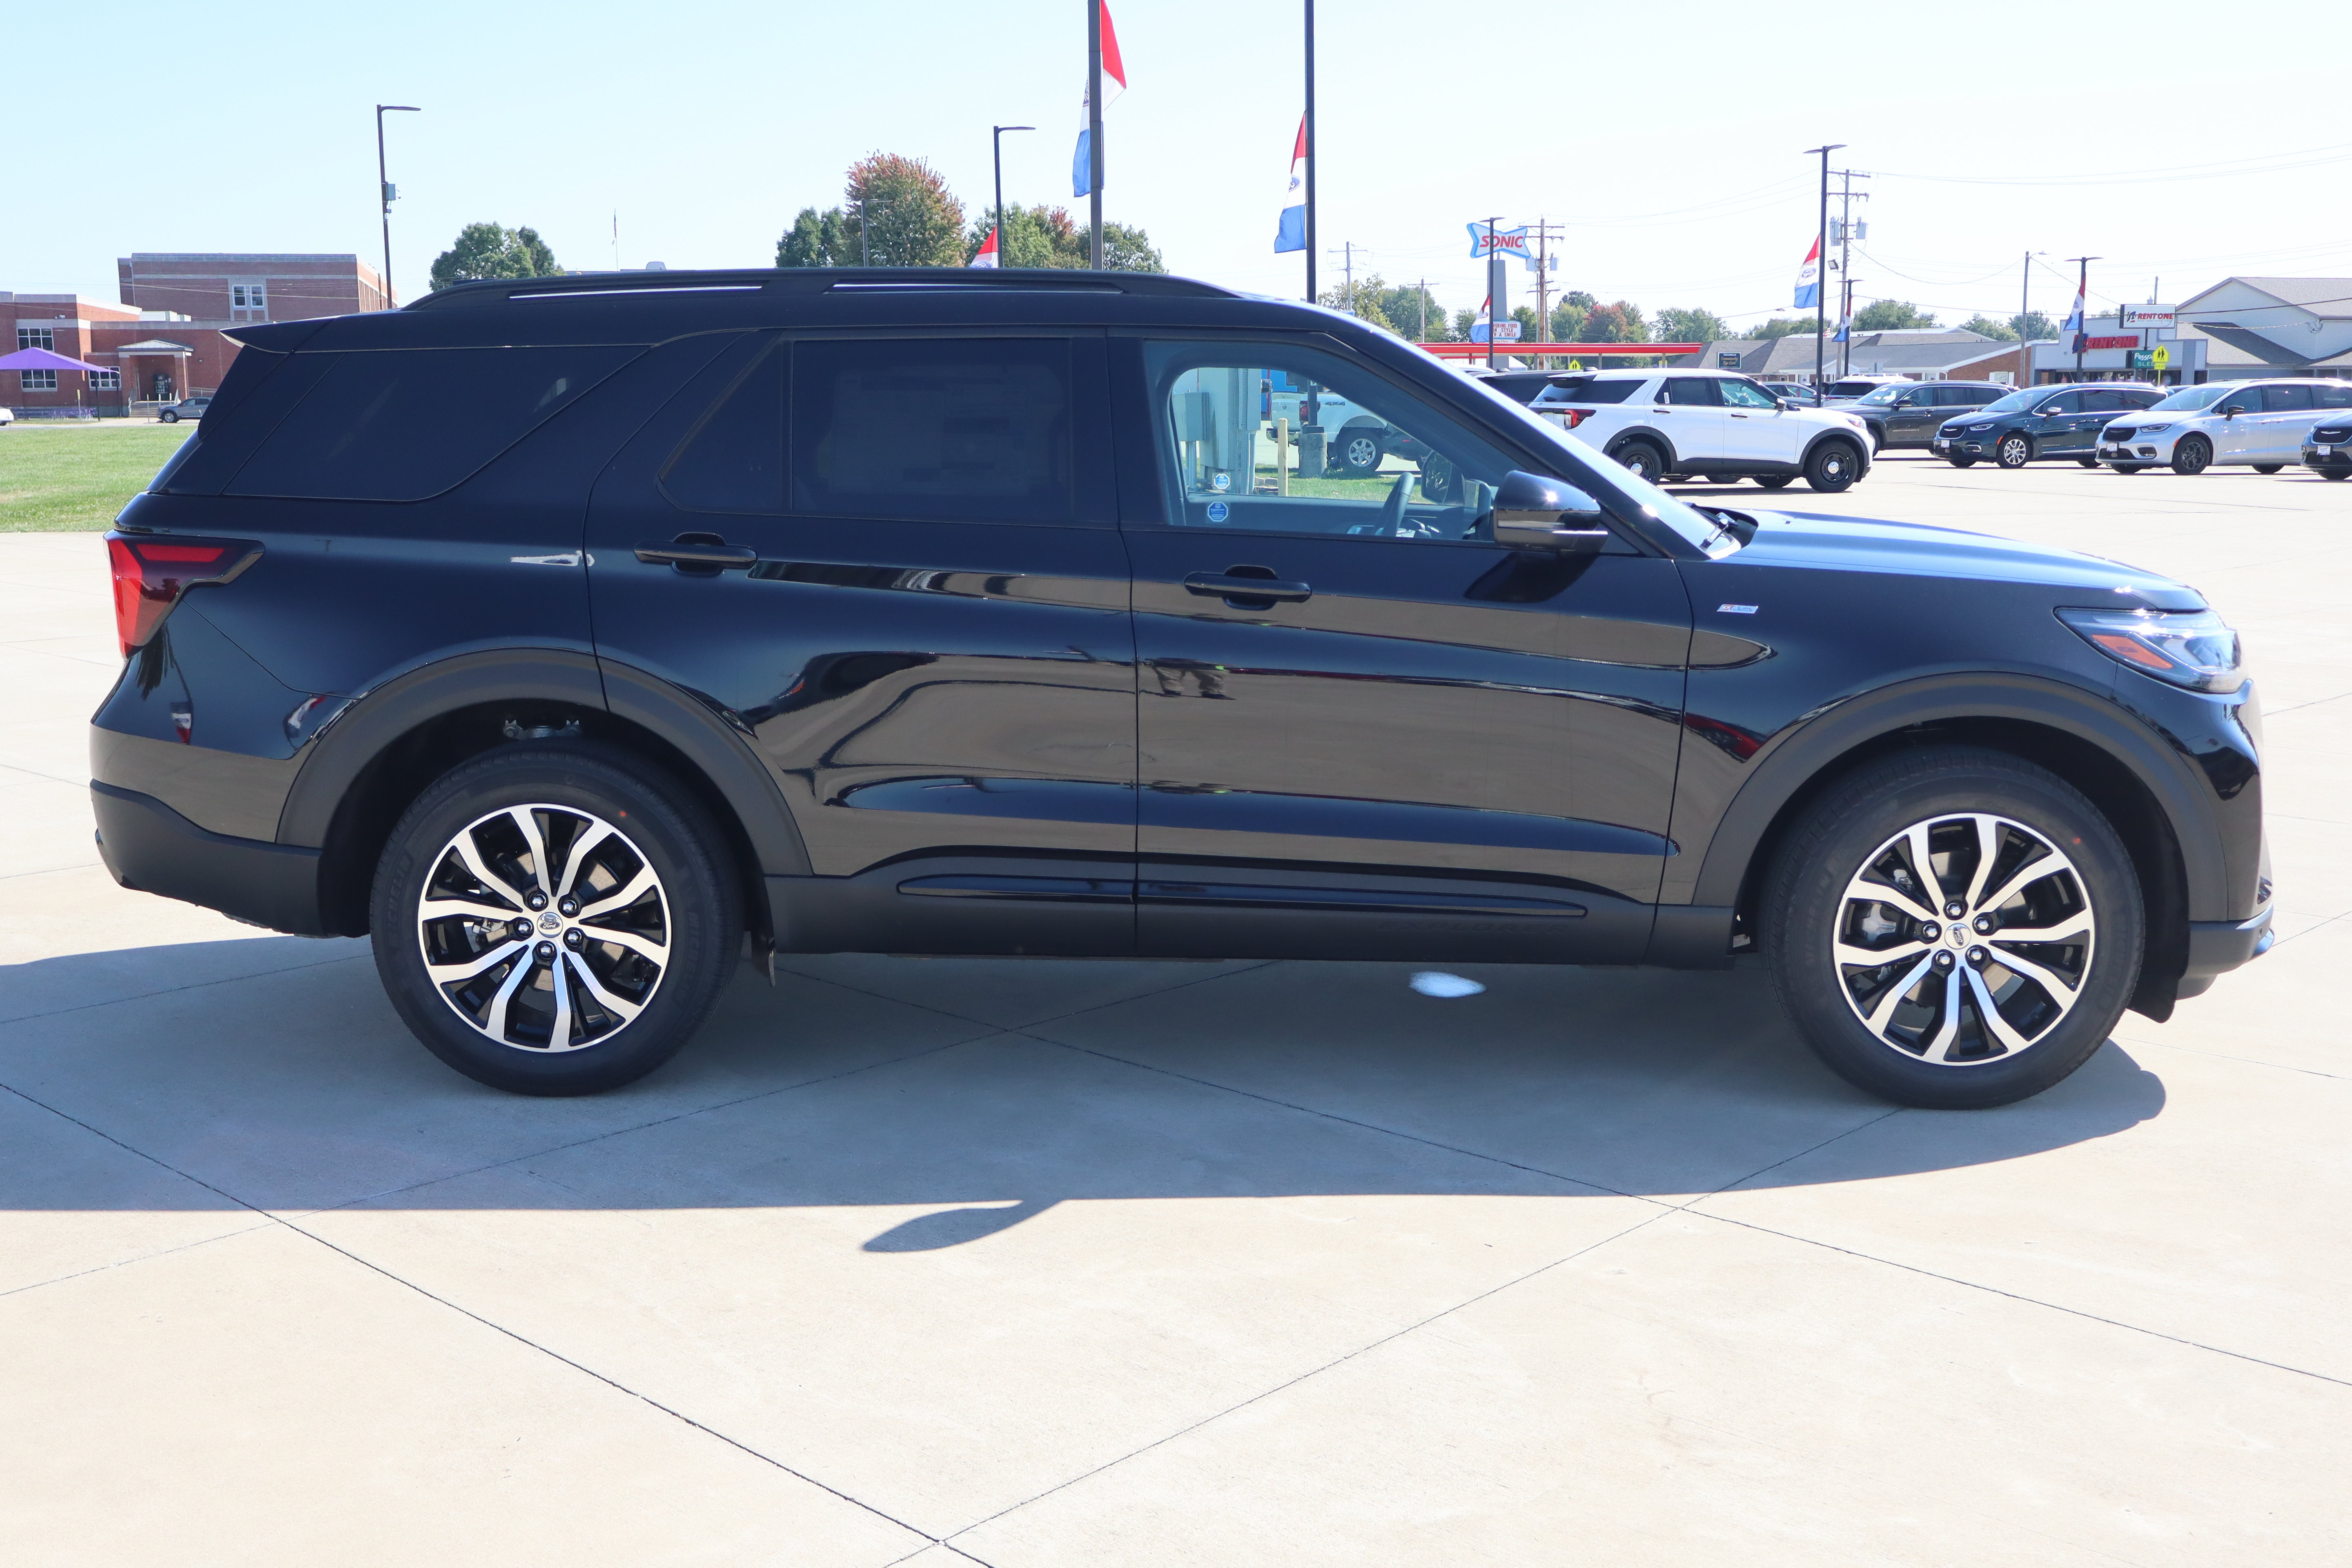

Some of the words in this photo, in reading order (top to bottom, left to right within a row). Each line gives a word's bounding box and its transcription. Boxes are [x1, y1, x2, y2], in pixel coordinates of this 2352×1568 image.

[1479, 235, 1523, 248] SONIC
[2087, 337, 2116, 349] RENT
[2115, 336, 2138, 348] ONE
[2134, 352, 2153, 361] Passp
[1954, 930, 1963, 942] Ford
